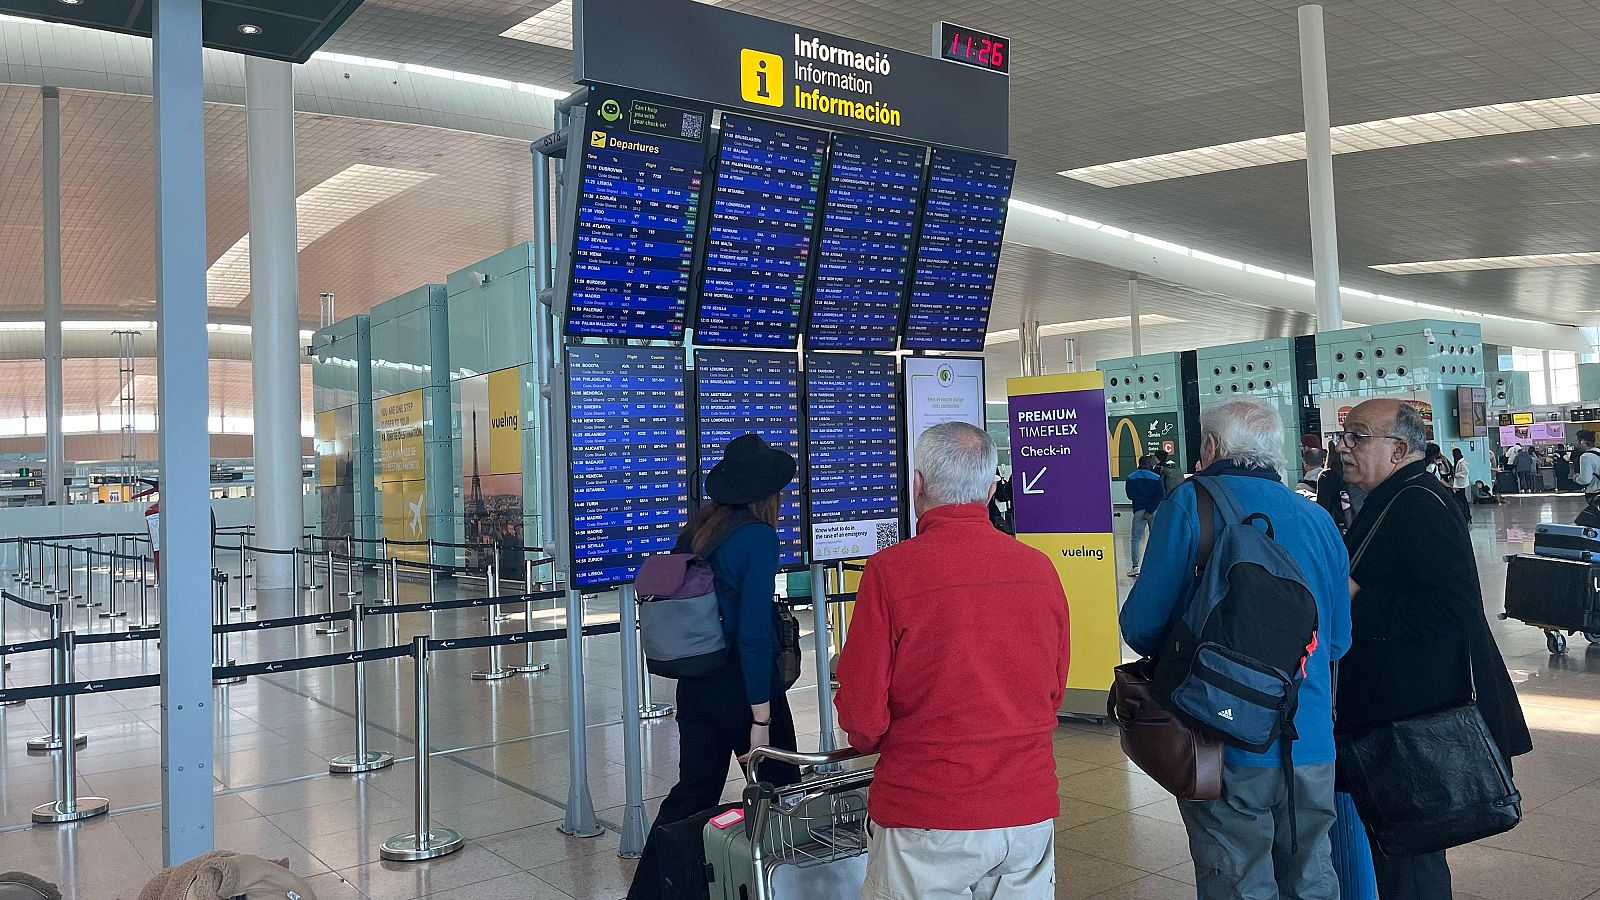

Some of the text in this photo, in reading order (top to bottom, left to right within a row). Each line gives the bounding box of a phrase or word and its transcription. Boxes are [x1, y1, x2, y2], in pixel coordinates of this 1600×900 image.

[794, 33, 890, 75] Informació
[952, 32, 1003, 68] 11:26
[794, 61, 872, 94] Information
[795, 85, 900, 126] Información
[610, 138, 660, 154] Departures
[404, 402, 413, 412] STEP
[492, 412, 518, 430] vueling
[1018, 408, 1077, 422] PREMIUM
[1019, 424, 1078, 438] TIMEFLEX
[1021, 445, 1071, 457] Check-in
[1165, 444, 1171, 452] C
[1062, 546, 1104, 560] vueling
